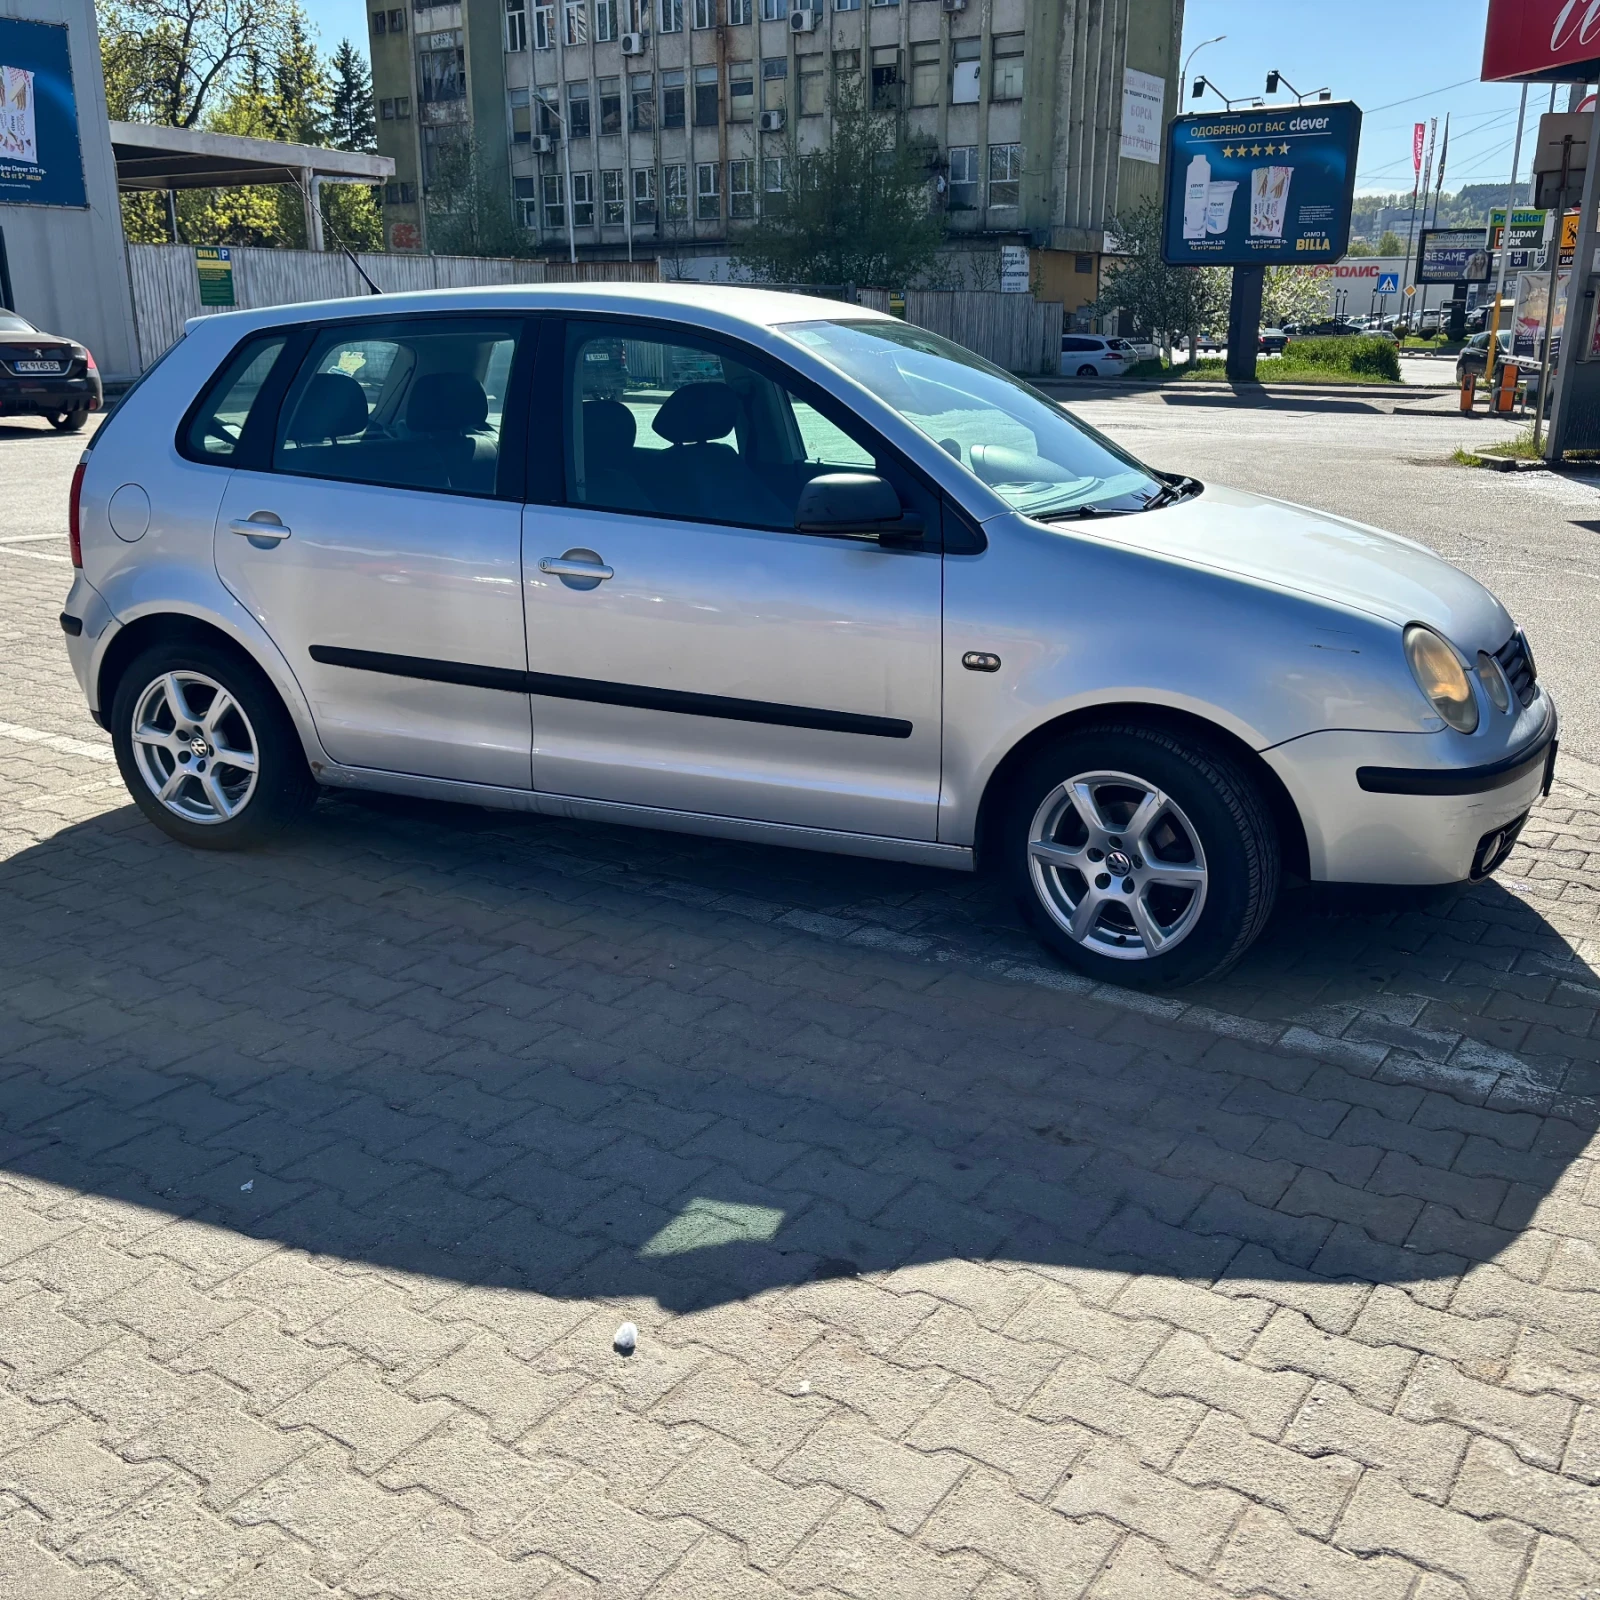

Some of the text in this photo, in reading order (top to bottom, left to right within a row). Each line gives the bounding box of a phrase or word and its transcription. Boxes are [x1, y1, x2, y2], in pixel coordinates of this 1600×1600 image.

[1190, 117, 1330, 138] ОДОБРЕНО ОТ ВАС clever
[1494, 213, 1543, 223] Prktiker
[1296, 238, 1330, 250] BILLA
[1498, 238, 1521, 246] PRK
[197, 249, 228, 259] BILLA P
[1424, 252, 1466, 261] SESAME
